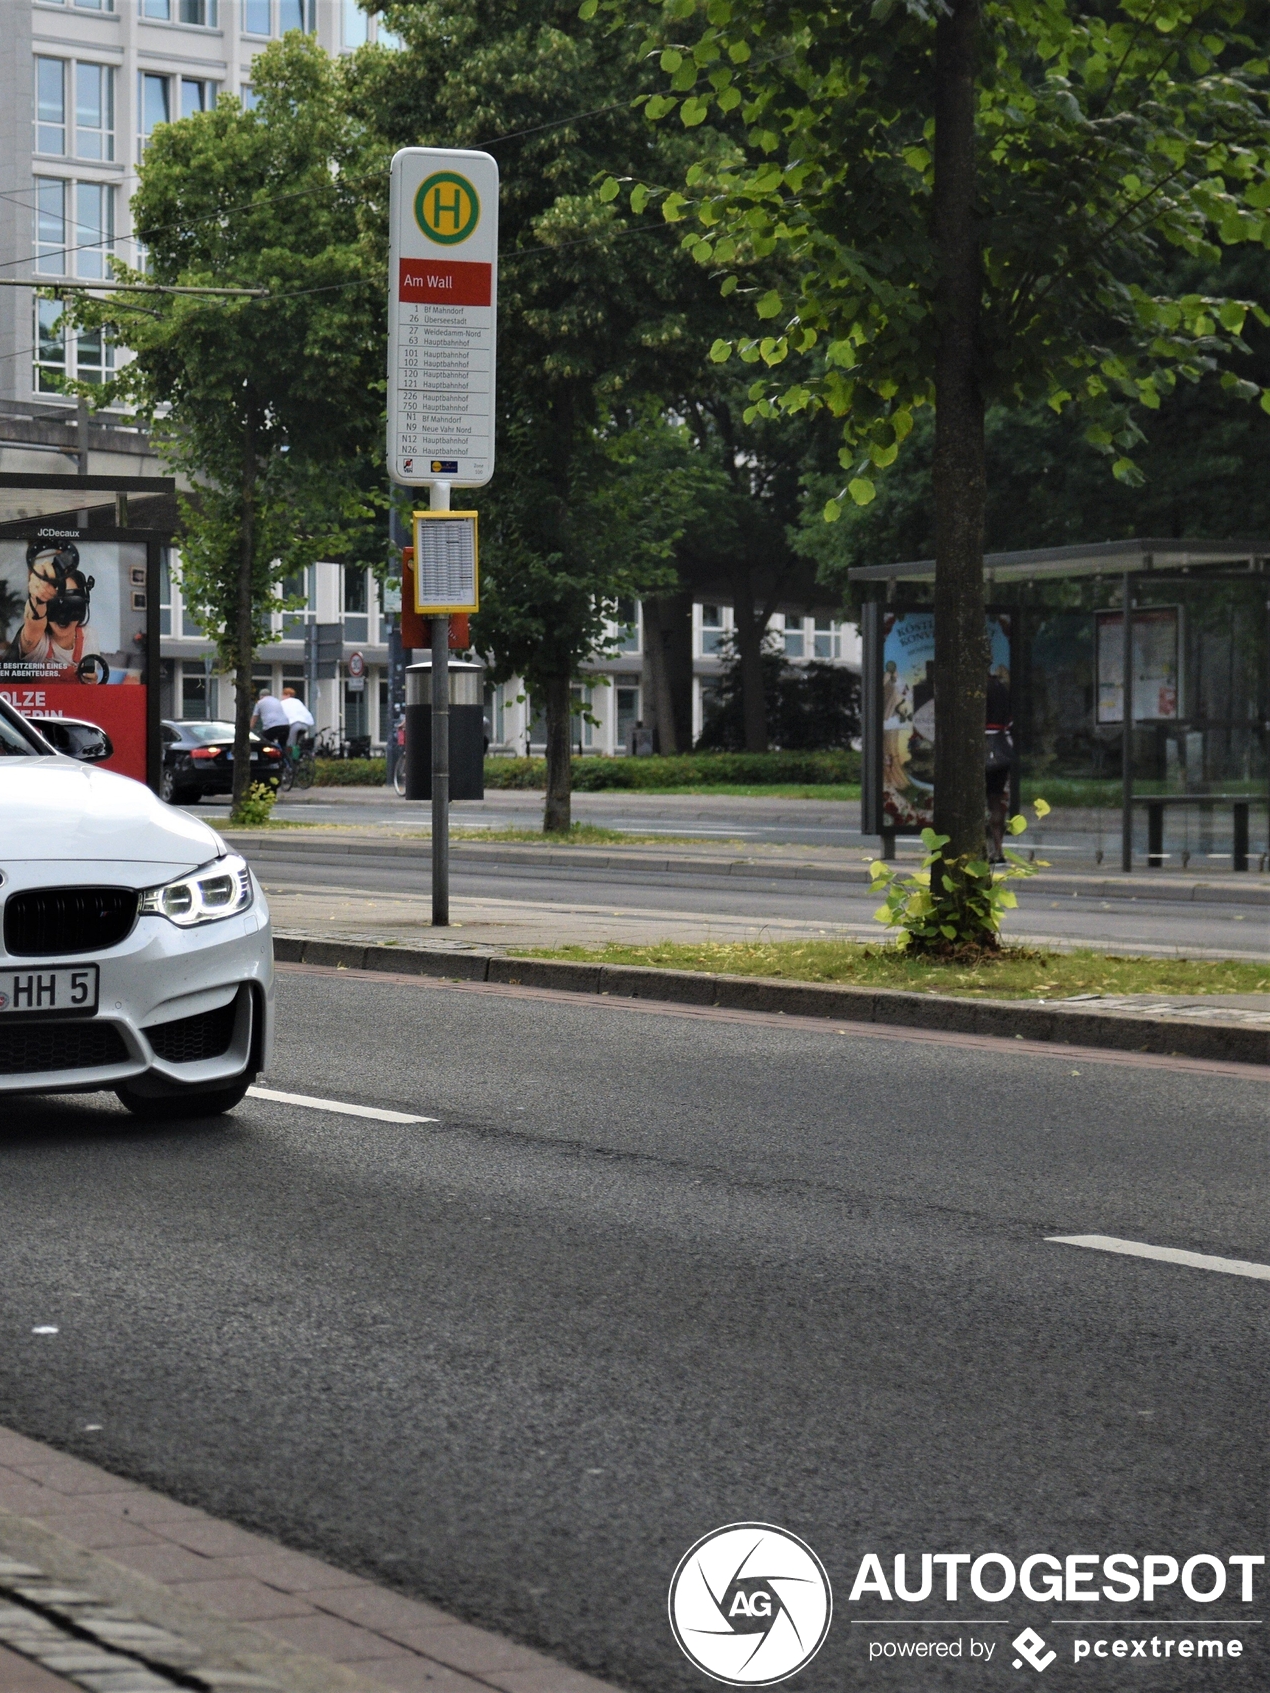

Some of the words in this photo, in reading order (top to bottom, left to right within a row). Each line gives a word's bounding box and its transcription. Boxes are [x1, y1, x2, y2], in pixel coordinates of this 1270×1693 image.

[434, 188, 461, 229] H
[404, 274, 424, 287] Am
[427, 275, 452, 289] Wall
[415, 305, 418, 313] 1
[432, 307, 464, 315] Mahndorf
[424, 315, 467, 325] Überseestadt
[409, 327, 418, 335] 27
[424, 328, 481, 338] Weidedamm-Nord
[409, 336, 418, 344] 63
[424, 338, 470, 347] Hauptbahnhof
[404, 349, 418, 357] 101
[423, 351, 469, 359] Hauptbahnhof
[404, 359, 418, 367] 102
[423, 360, 469, 368] Hauptbahnhof
[404, 370, 418, 378] 120
[423, 371, 469, 379] Hauptbahnhof
[404, 380, 417, 388] 121
[423, 381, 469, 390] Hauptbahnhof
[403, 392, 417, 400] 226
[422, 394, 469, 402] Hauptbahnhof
[403, 402, 417, 410] 750
[422, 404, 469, 412] Hauptbahnhof
[406, 412, 416, 421] N1
[431, 416, 462, 424] Mahndorf
[406, 423, 417, 431] N9
[422, 425, 439, 433] Neue
[456, 426, 472, 434] Nord
[401, 435, 417, 443] N12
[422, 436, 469, 445] Hauptbahnhof
[401, 445, 417, 454] N26
[422, 447, 469, 455] Hauptbahnhof
[37, 528, 80, 538] JCDecaux
[13, 974, 56, 1007] HH
[71, 972, 88, 1004] 5
